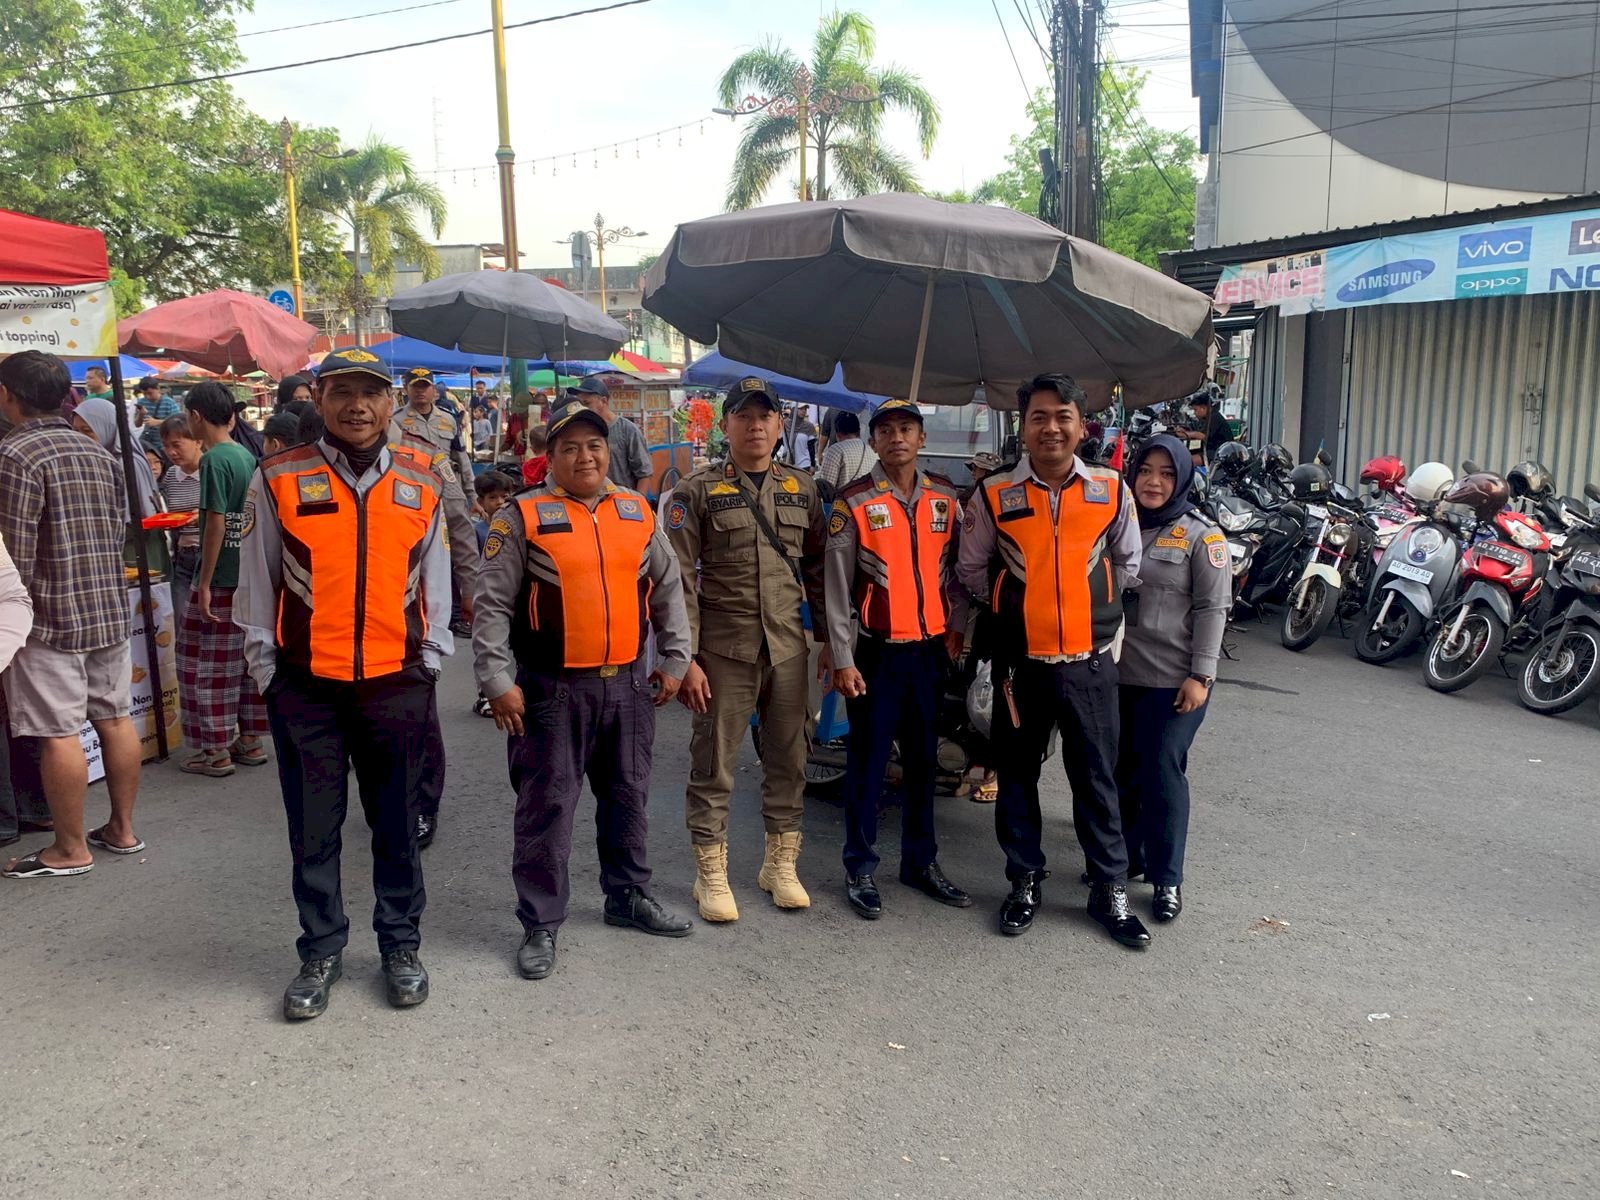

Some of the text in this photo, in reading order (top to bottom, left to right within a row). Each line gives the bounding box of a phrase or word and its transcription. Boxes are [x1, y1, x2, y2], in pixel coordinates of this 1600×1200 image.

[1465, 240, 1524, 259] vivo
[1348, 270, 1423, 292] SAMSUNG
[1461, 276, 1521, 291] oppo
[13, 287, 49, 298] Non
[5, 330, 60, 346] topping)
[132, 694, 152, 706] Non
